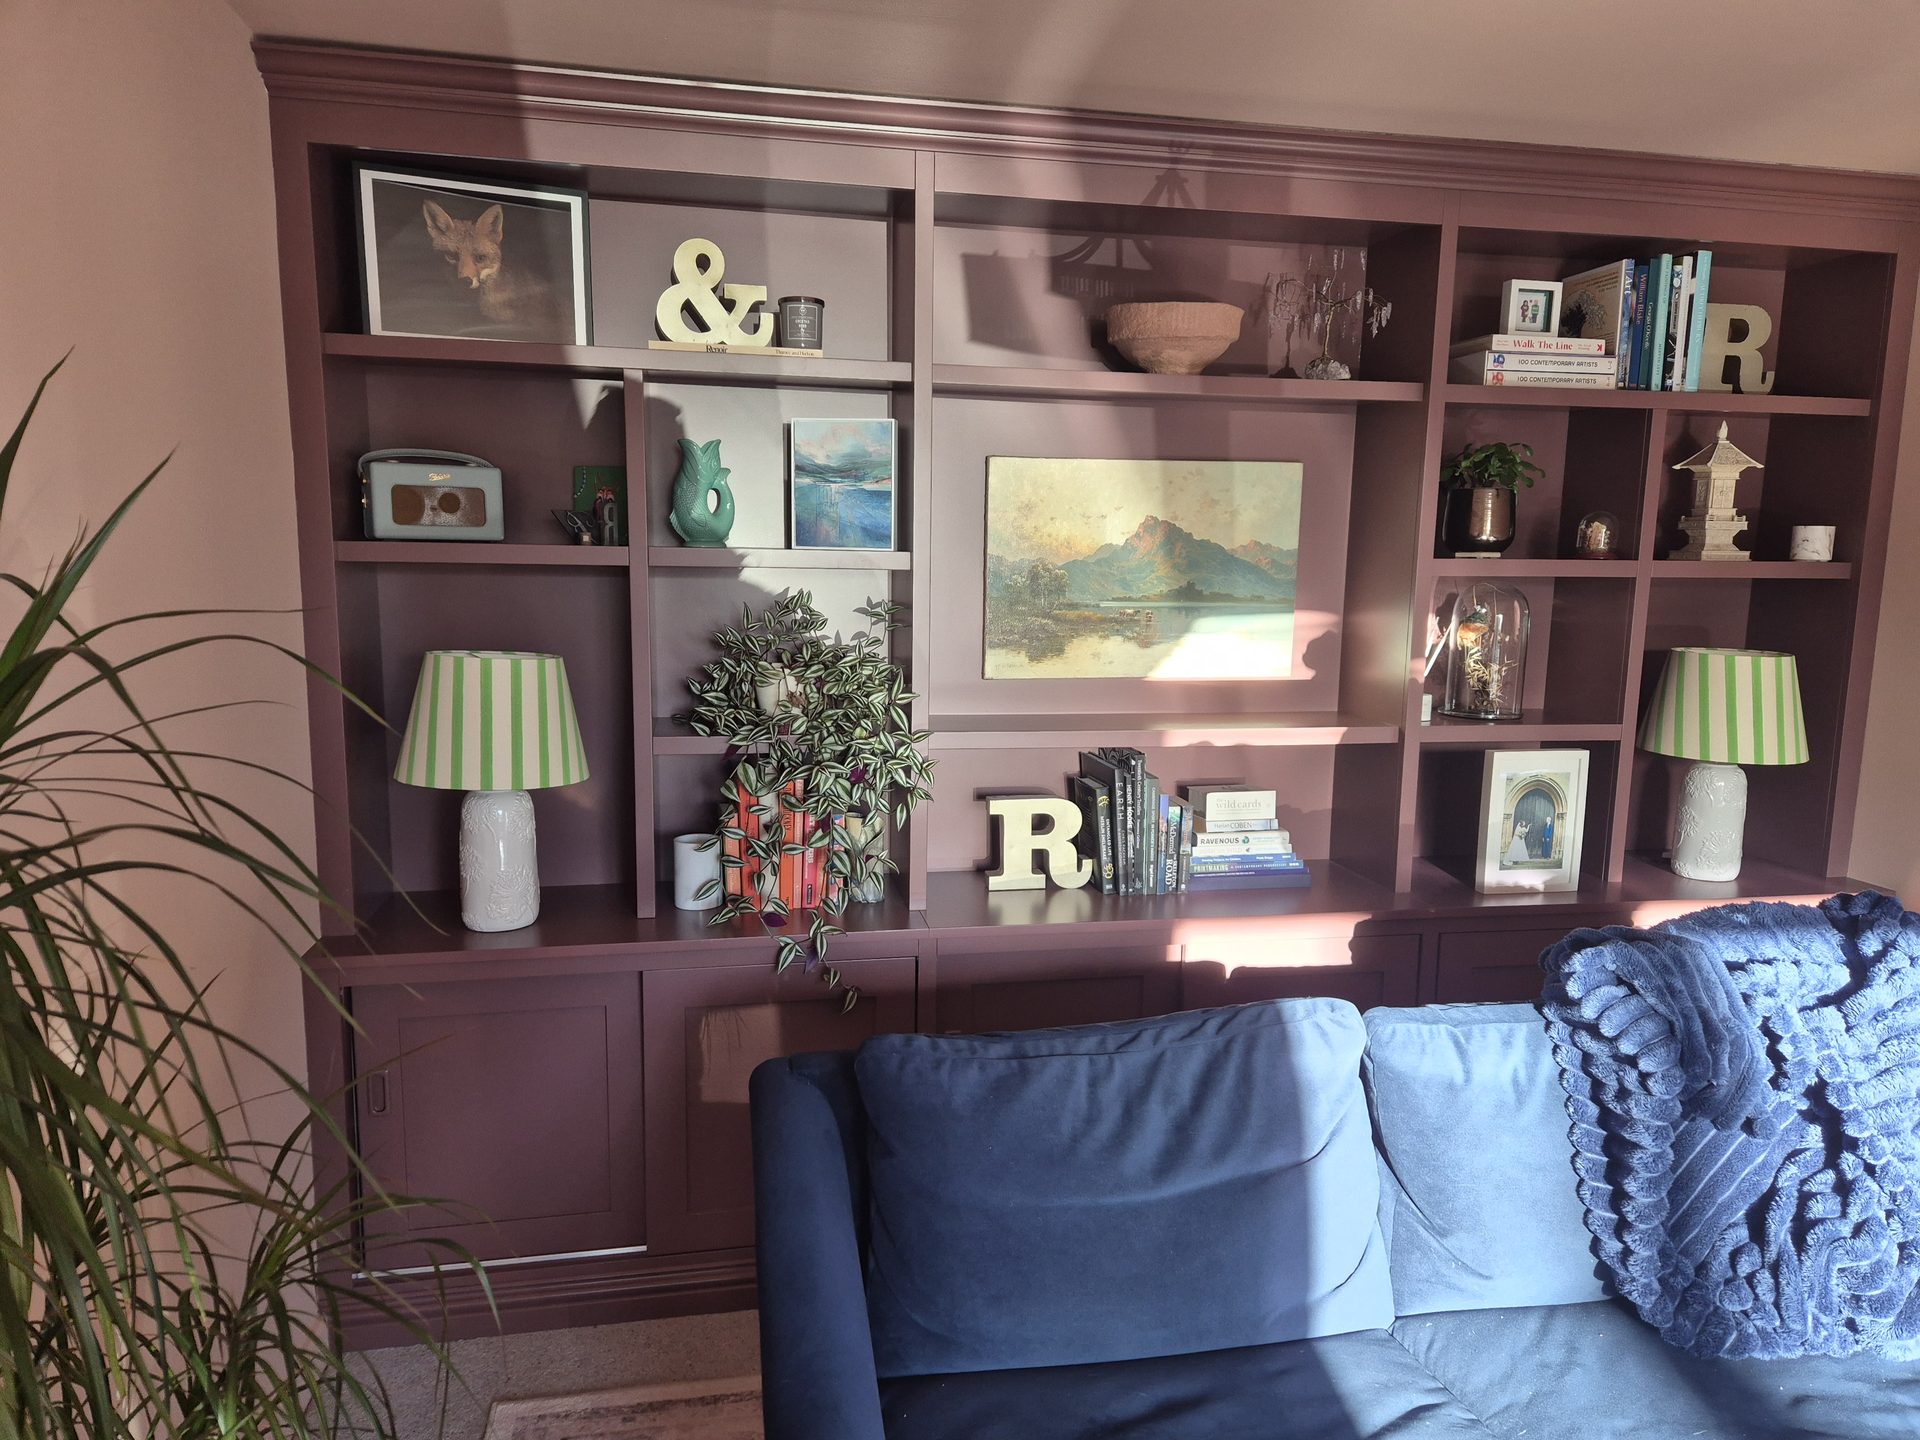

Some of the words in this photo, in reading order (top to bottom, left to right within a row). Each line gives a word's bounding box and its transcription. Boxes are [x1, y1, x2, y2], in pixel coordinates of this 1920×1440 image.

[1624, 275, 1632, 296] Art
[1638, 273, 1647, 303] William
[1636, 303, 1644, 325] Blake
[1645, 302, 1654, 324] Georgia
[1513, 339, 1535, 349] Walk
[1537, 340, 1554, 350] The
[1555, 341, 1573, 351] Line
[1700, 302, 1776, 395] R
[1530, 359, 1575, 367] CONTEMPORARY
[1529, 376, 1574, 384] CONTEMPORARY
[1135, 781, 1143, 799] Century
[1116, 782, 1124, 820] EARTH
[1216, 799, 1236, 809] wild
[1237, 799, 1262, 809] cards
[1230, 821, 1253, 829] COBEN
[987, 794, 1094, 892] R
[1168, 821, 1178, 854] McDermid
[1200, 837, 1240, 845] RAVENOUS
[1165, 859, 1173, 886] ROAD
[1170, 860, 1178, 888] SKELETON
[1193, 864, 1229, 873] PRINTMAKING
